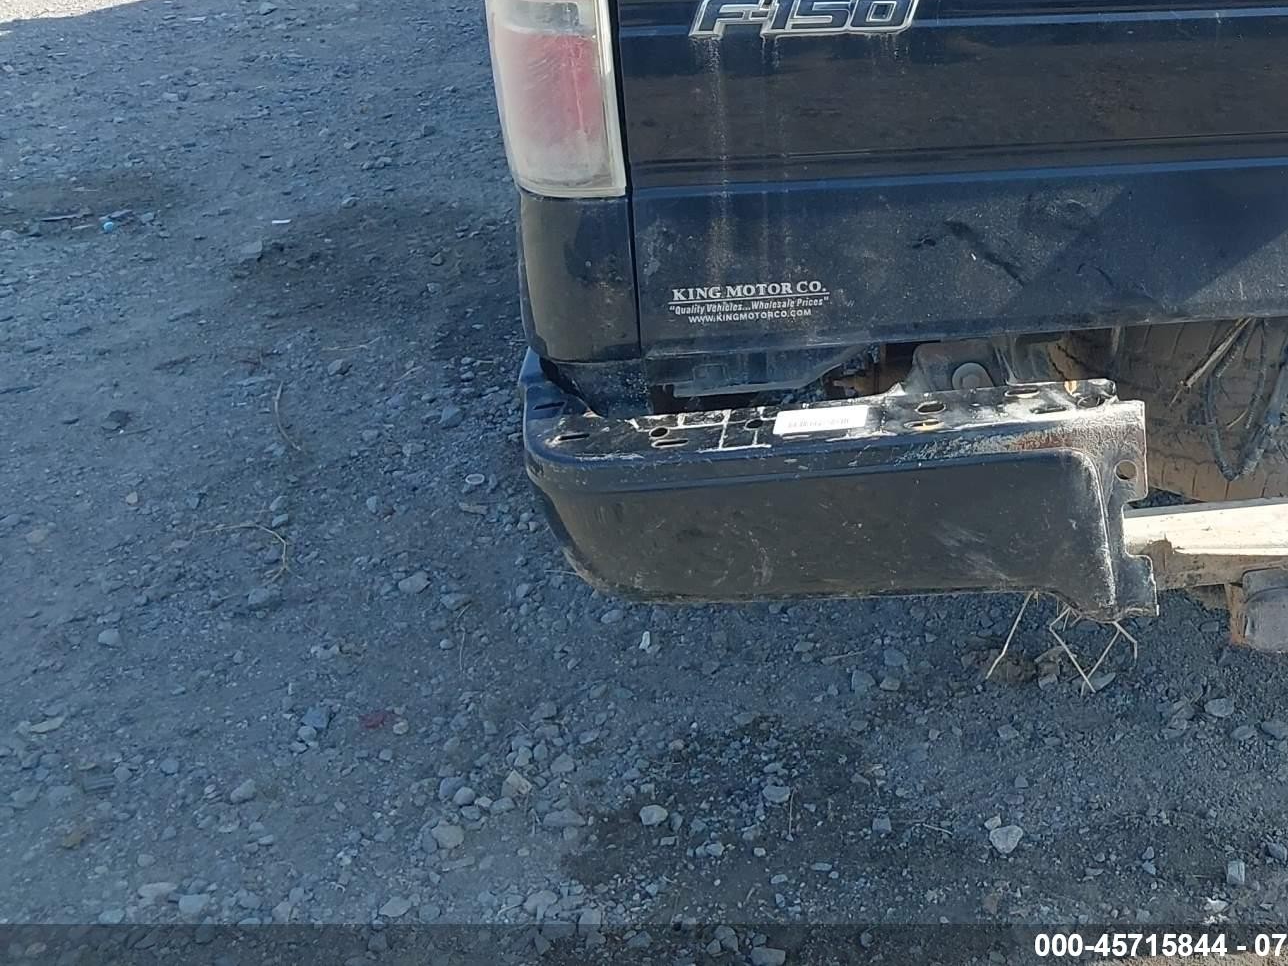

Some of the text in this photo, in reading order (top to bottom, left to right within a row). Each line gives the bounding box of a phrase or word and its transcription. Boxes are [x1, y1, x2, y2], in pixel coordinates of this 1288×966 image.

[672, 281, 827, 301] KING MOTOR CO.
